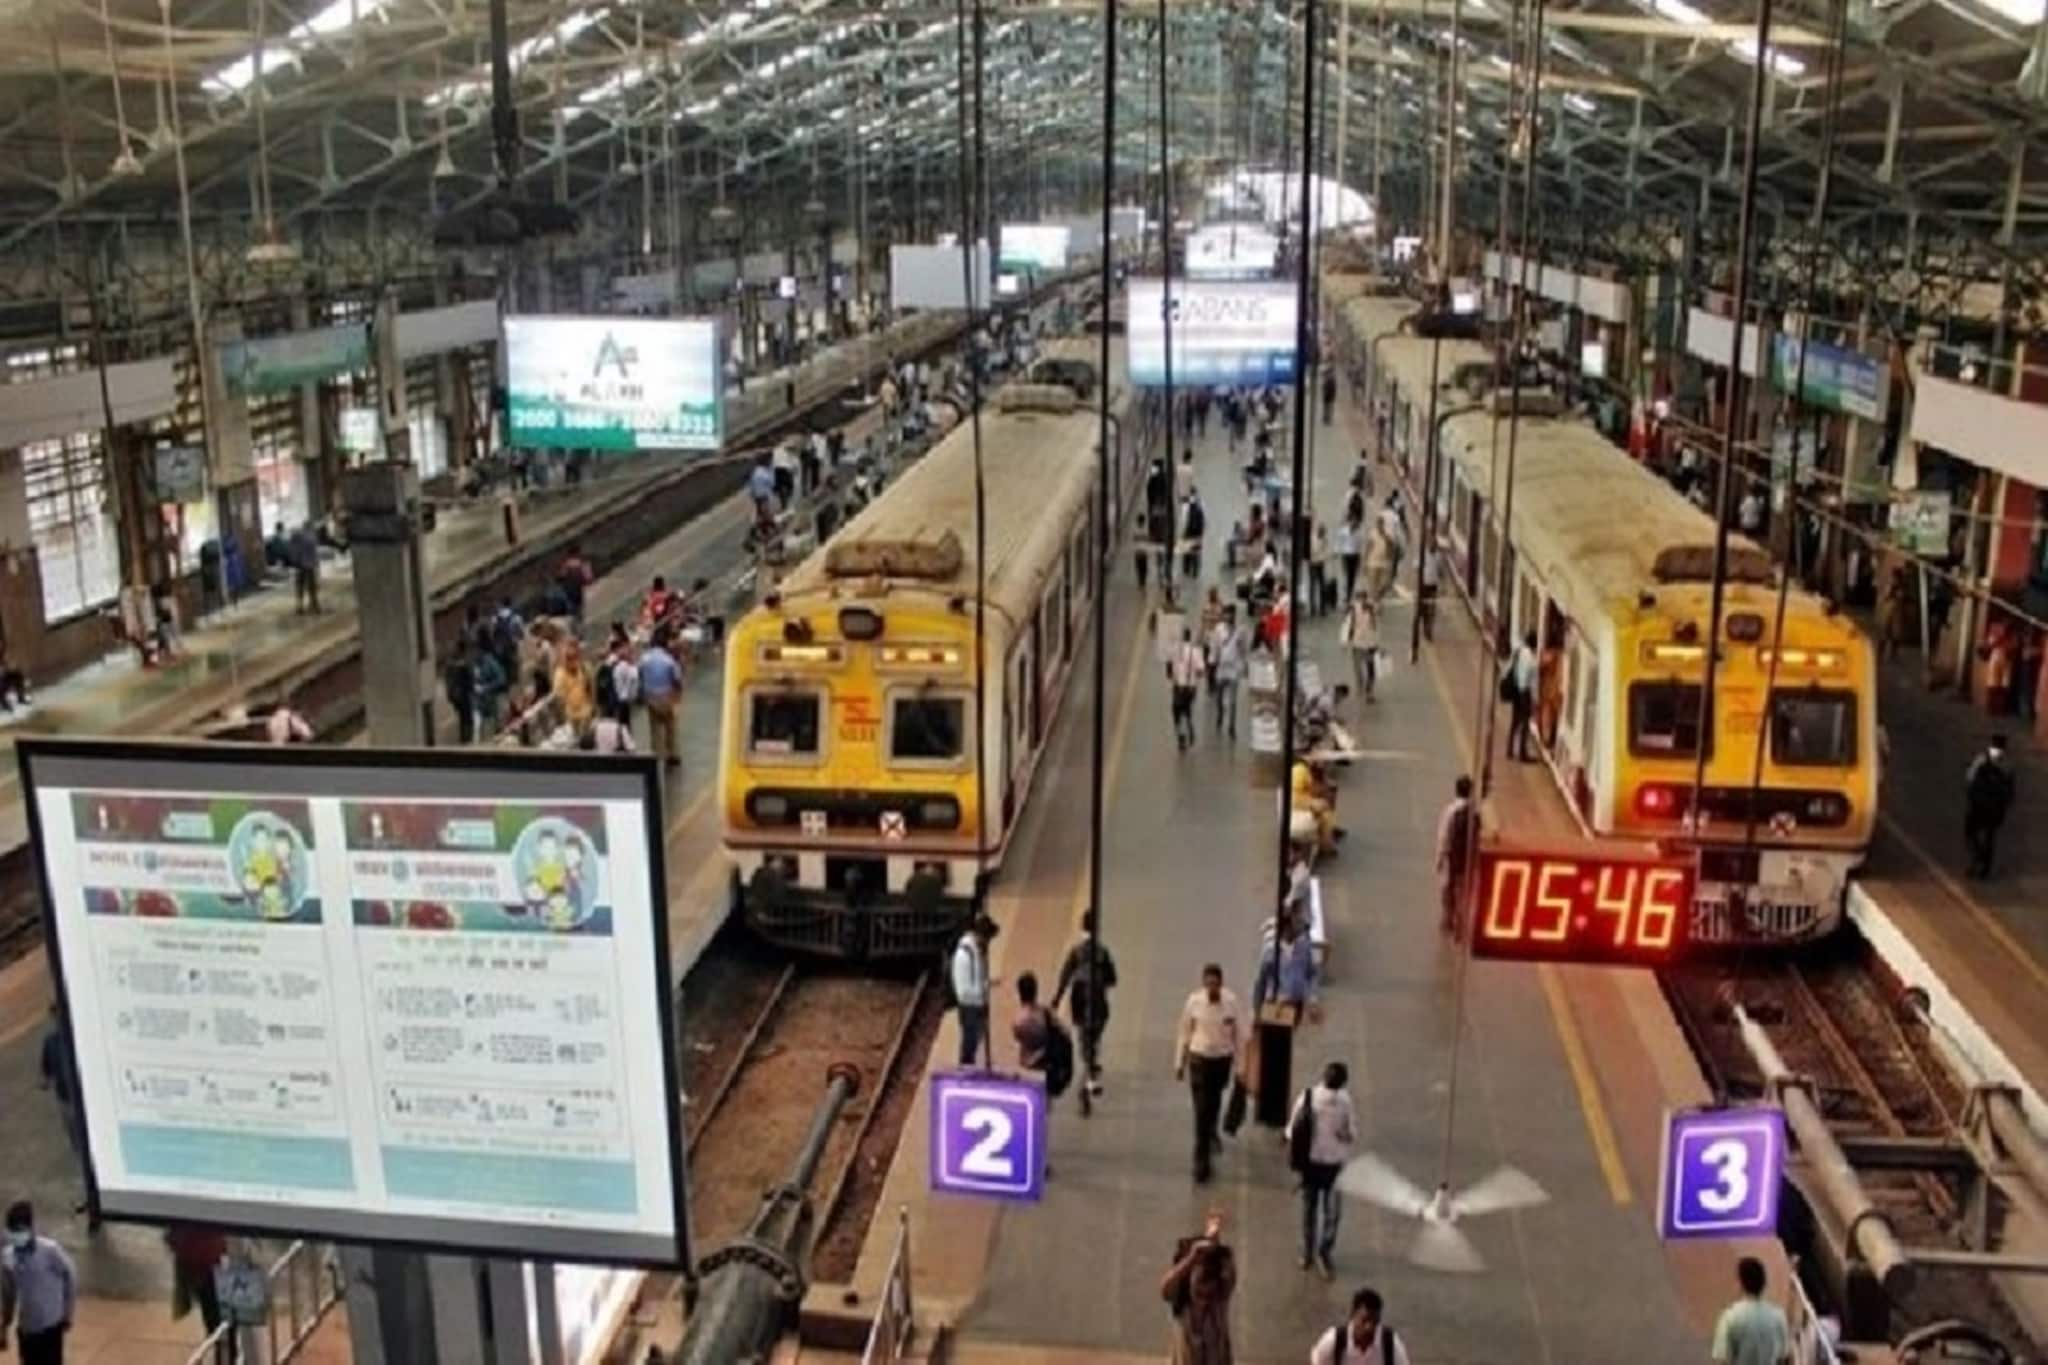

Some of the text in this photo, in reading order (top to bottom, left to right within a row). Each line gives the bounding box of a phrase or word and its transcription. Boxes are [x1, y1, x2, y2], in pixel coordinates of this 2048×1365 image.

[1483, 861, 1684, 948] 05:46
[960, 1106, 1013, 1177] 2
[1698, 1138, 1749, 1214] 3
